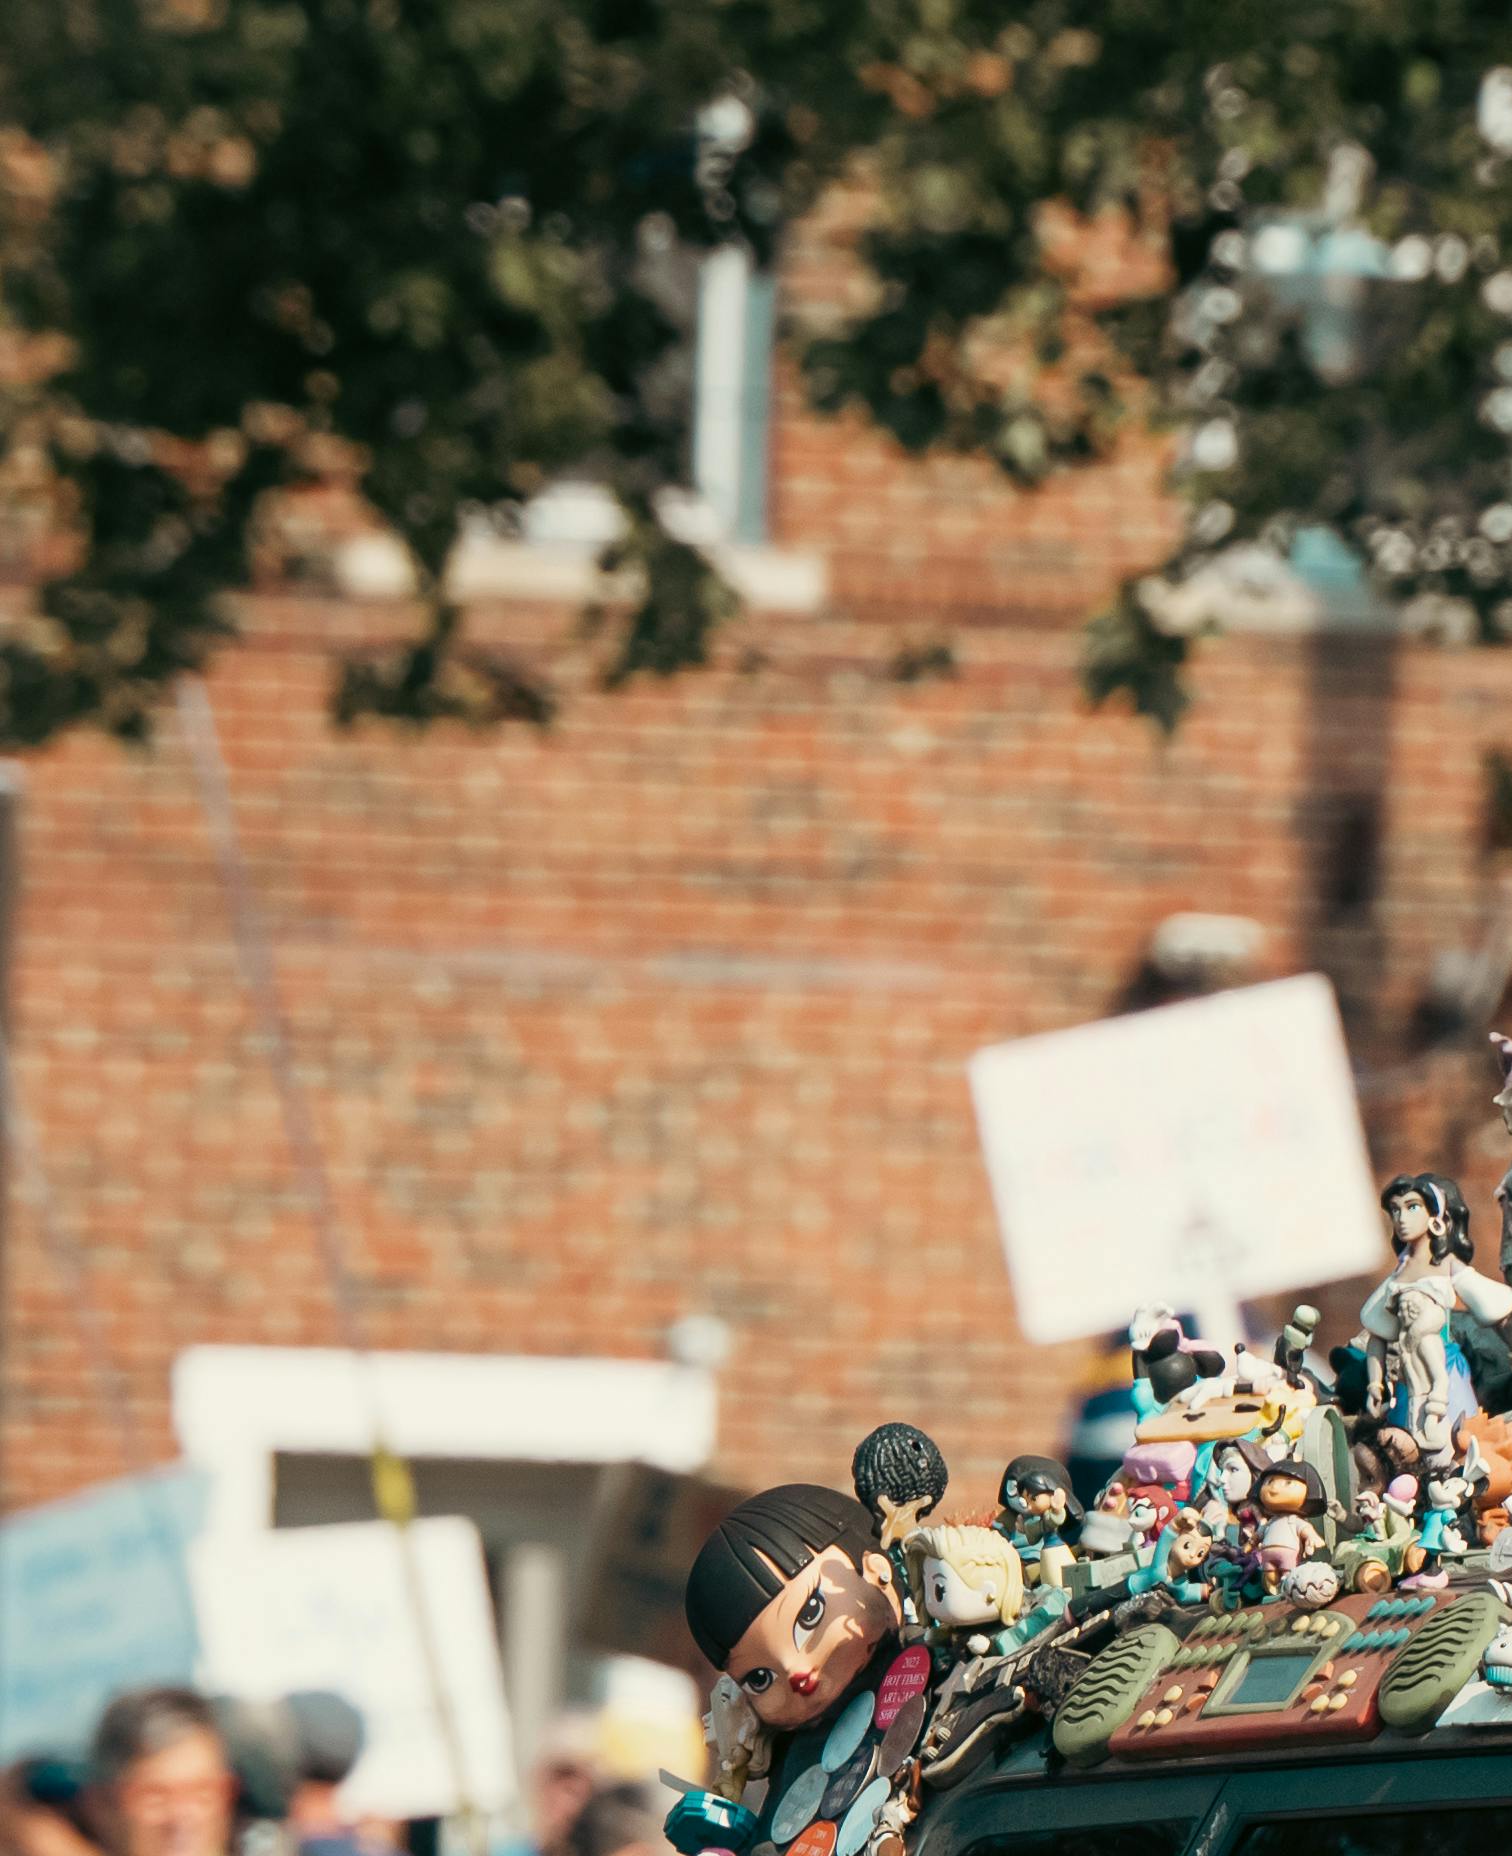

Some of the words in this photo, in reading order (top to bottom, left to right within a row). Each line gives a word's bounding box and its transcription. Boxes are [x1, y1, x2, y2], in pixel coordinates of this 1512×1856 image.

[883, 1674, 901, 1687] HOT
[902, 1673, 925, 1686] TIMES
[879, 1708, 900, 1721] SHO
